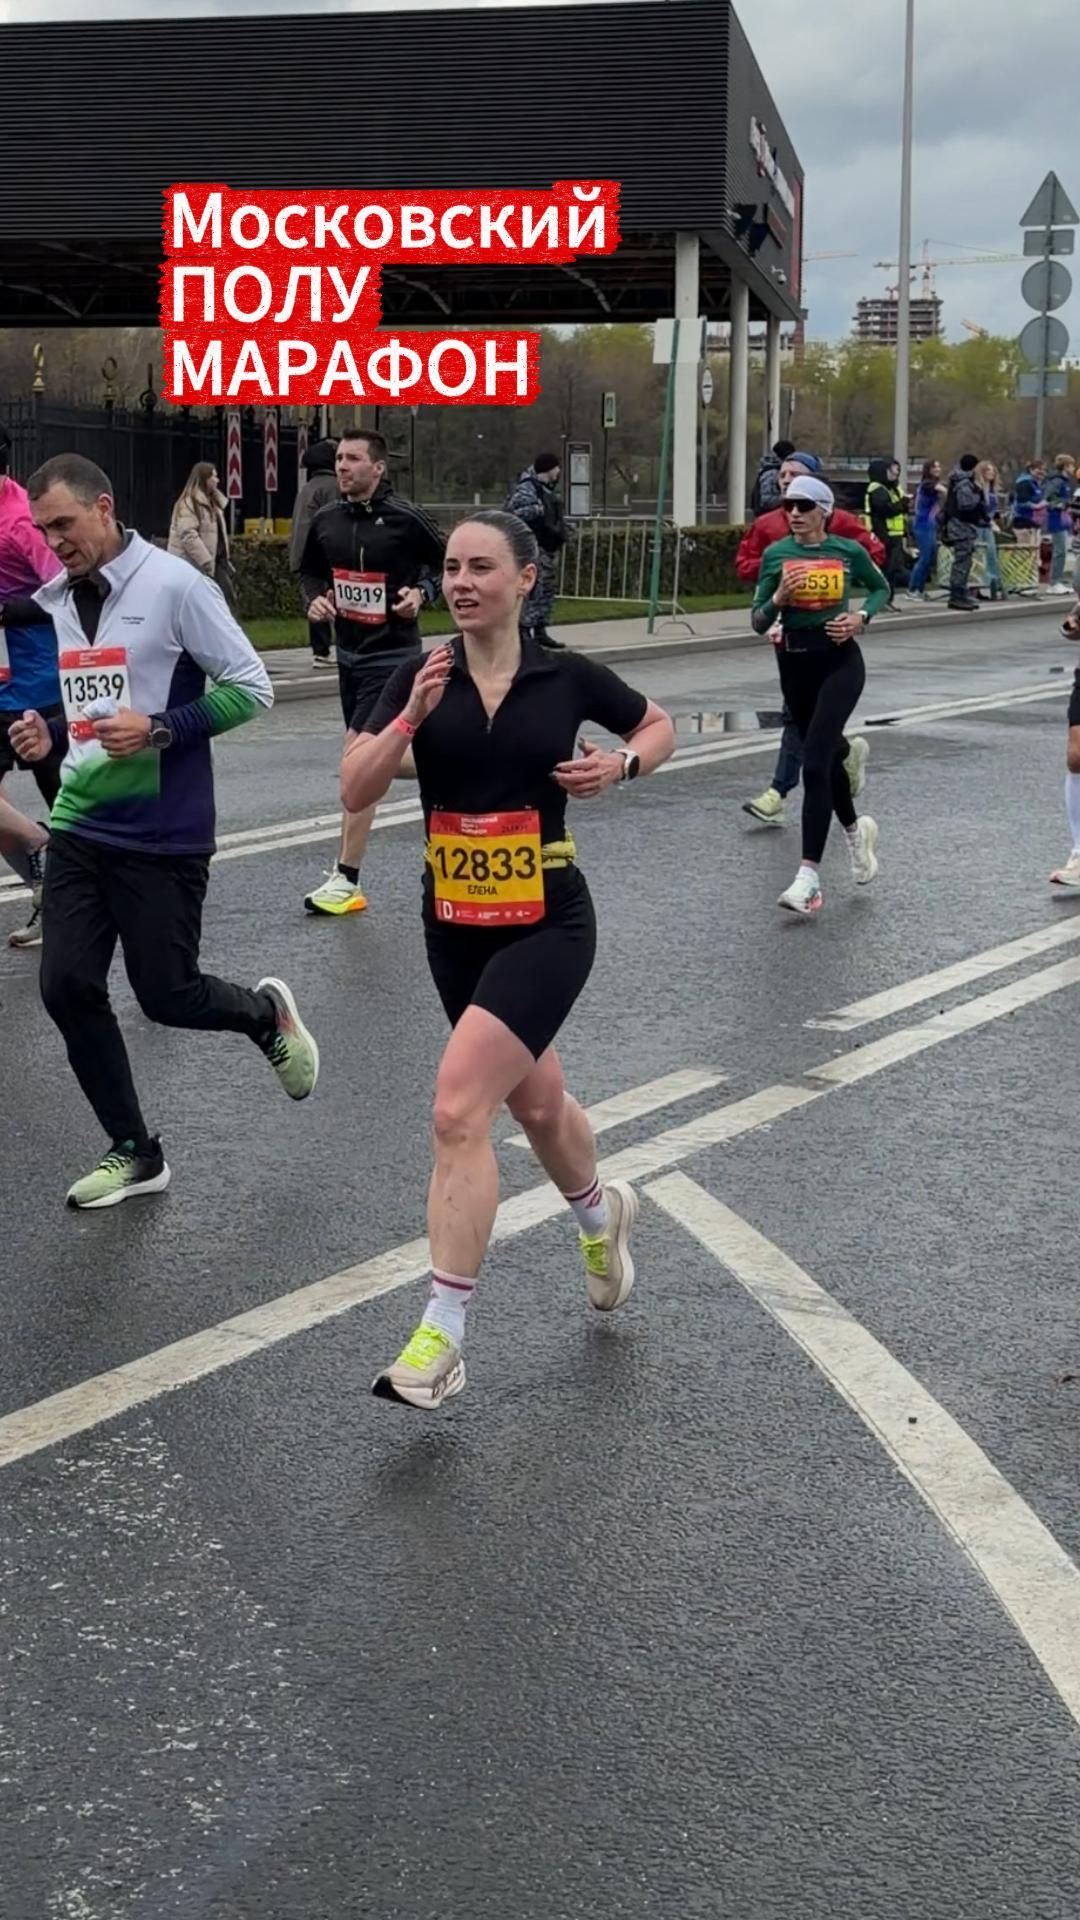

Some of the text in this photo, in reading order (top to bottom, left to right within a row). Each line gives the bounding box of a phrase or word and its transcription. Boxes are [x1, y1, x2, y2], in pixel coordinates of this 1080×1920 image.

[337, 584, 383, 603] 10319
[63, 673, 125, 704] 13539
[435, 846, 537, 882] 12833
[467, 885, 498, 896] ЕЛЕНА
[443, 900, 453, 919] D
